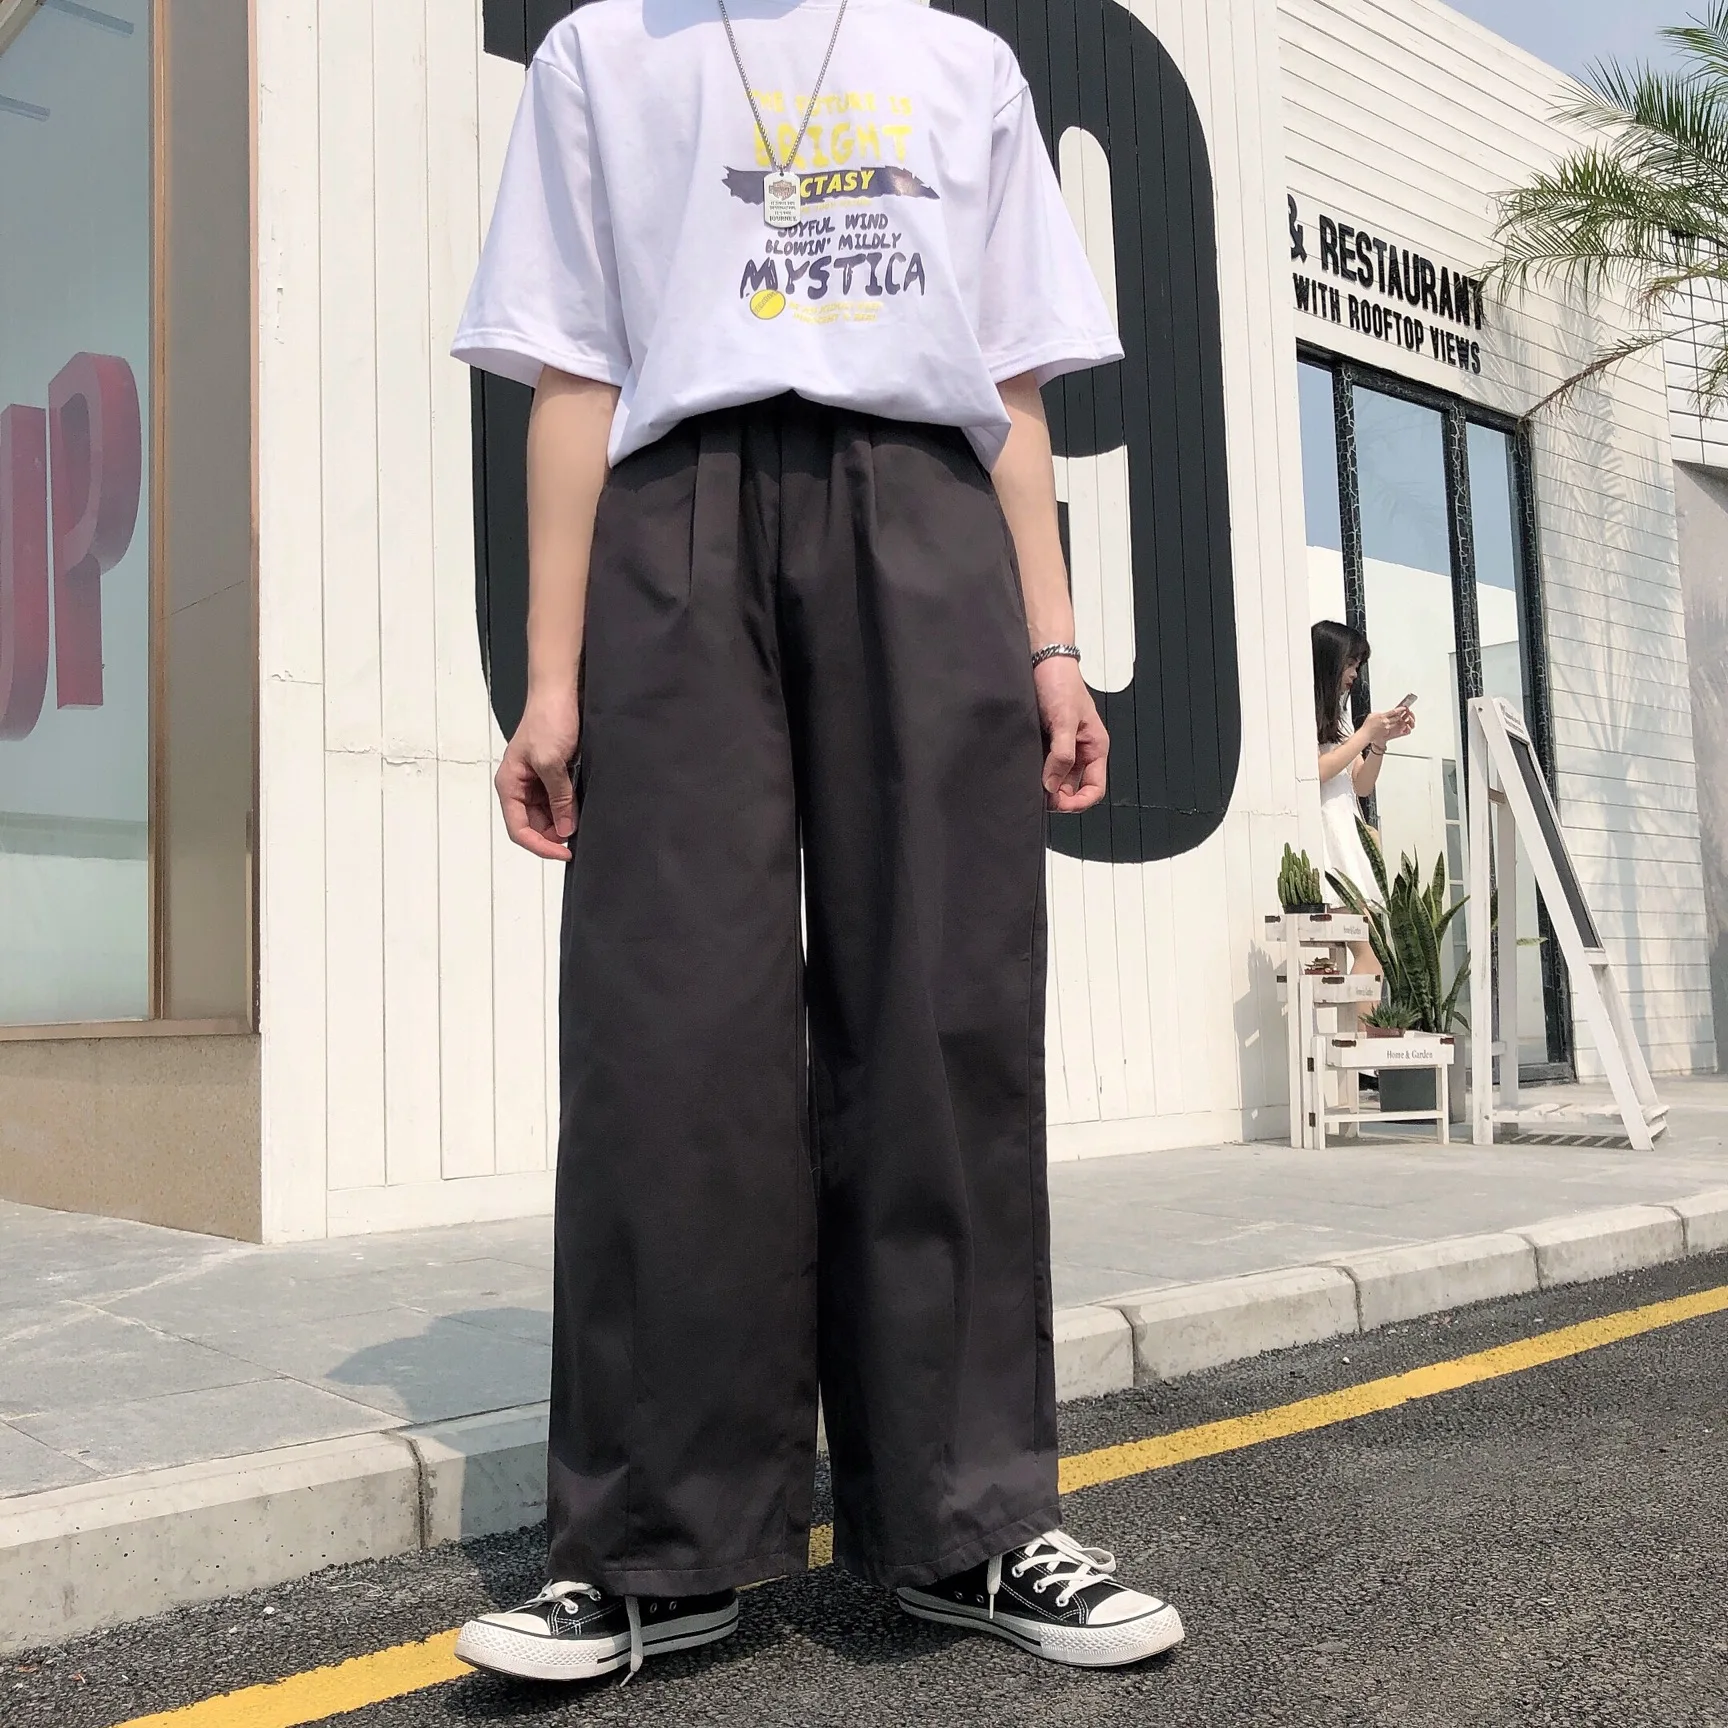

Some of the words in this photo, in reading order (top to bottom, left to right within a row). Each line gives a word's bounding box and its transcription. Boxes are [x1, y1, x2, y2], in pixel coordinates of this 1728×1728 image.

[889, 95, 913, 116] IS
[845, 212, 889, 231] WIND
[765, 237, 832, 256] BLOWIN'
[838, 232, 902, 251] MILDLY
[739, 252, 926, 301] MYSTICA
[1319, 214, 1485, 331] RESTAURANT
[1292, 272, 1342, 324] WITH
[1348, 293, 1425, 353] ROOFTOP
[1429, 325, 1482, 375] VIEWS
[1386, 1050, 1404, 1059] Home
[1405, 1050, 1411, 1060] &
[1411, 1049, 1433, 1059] Garden
